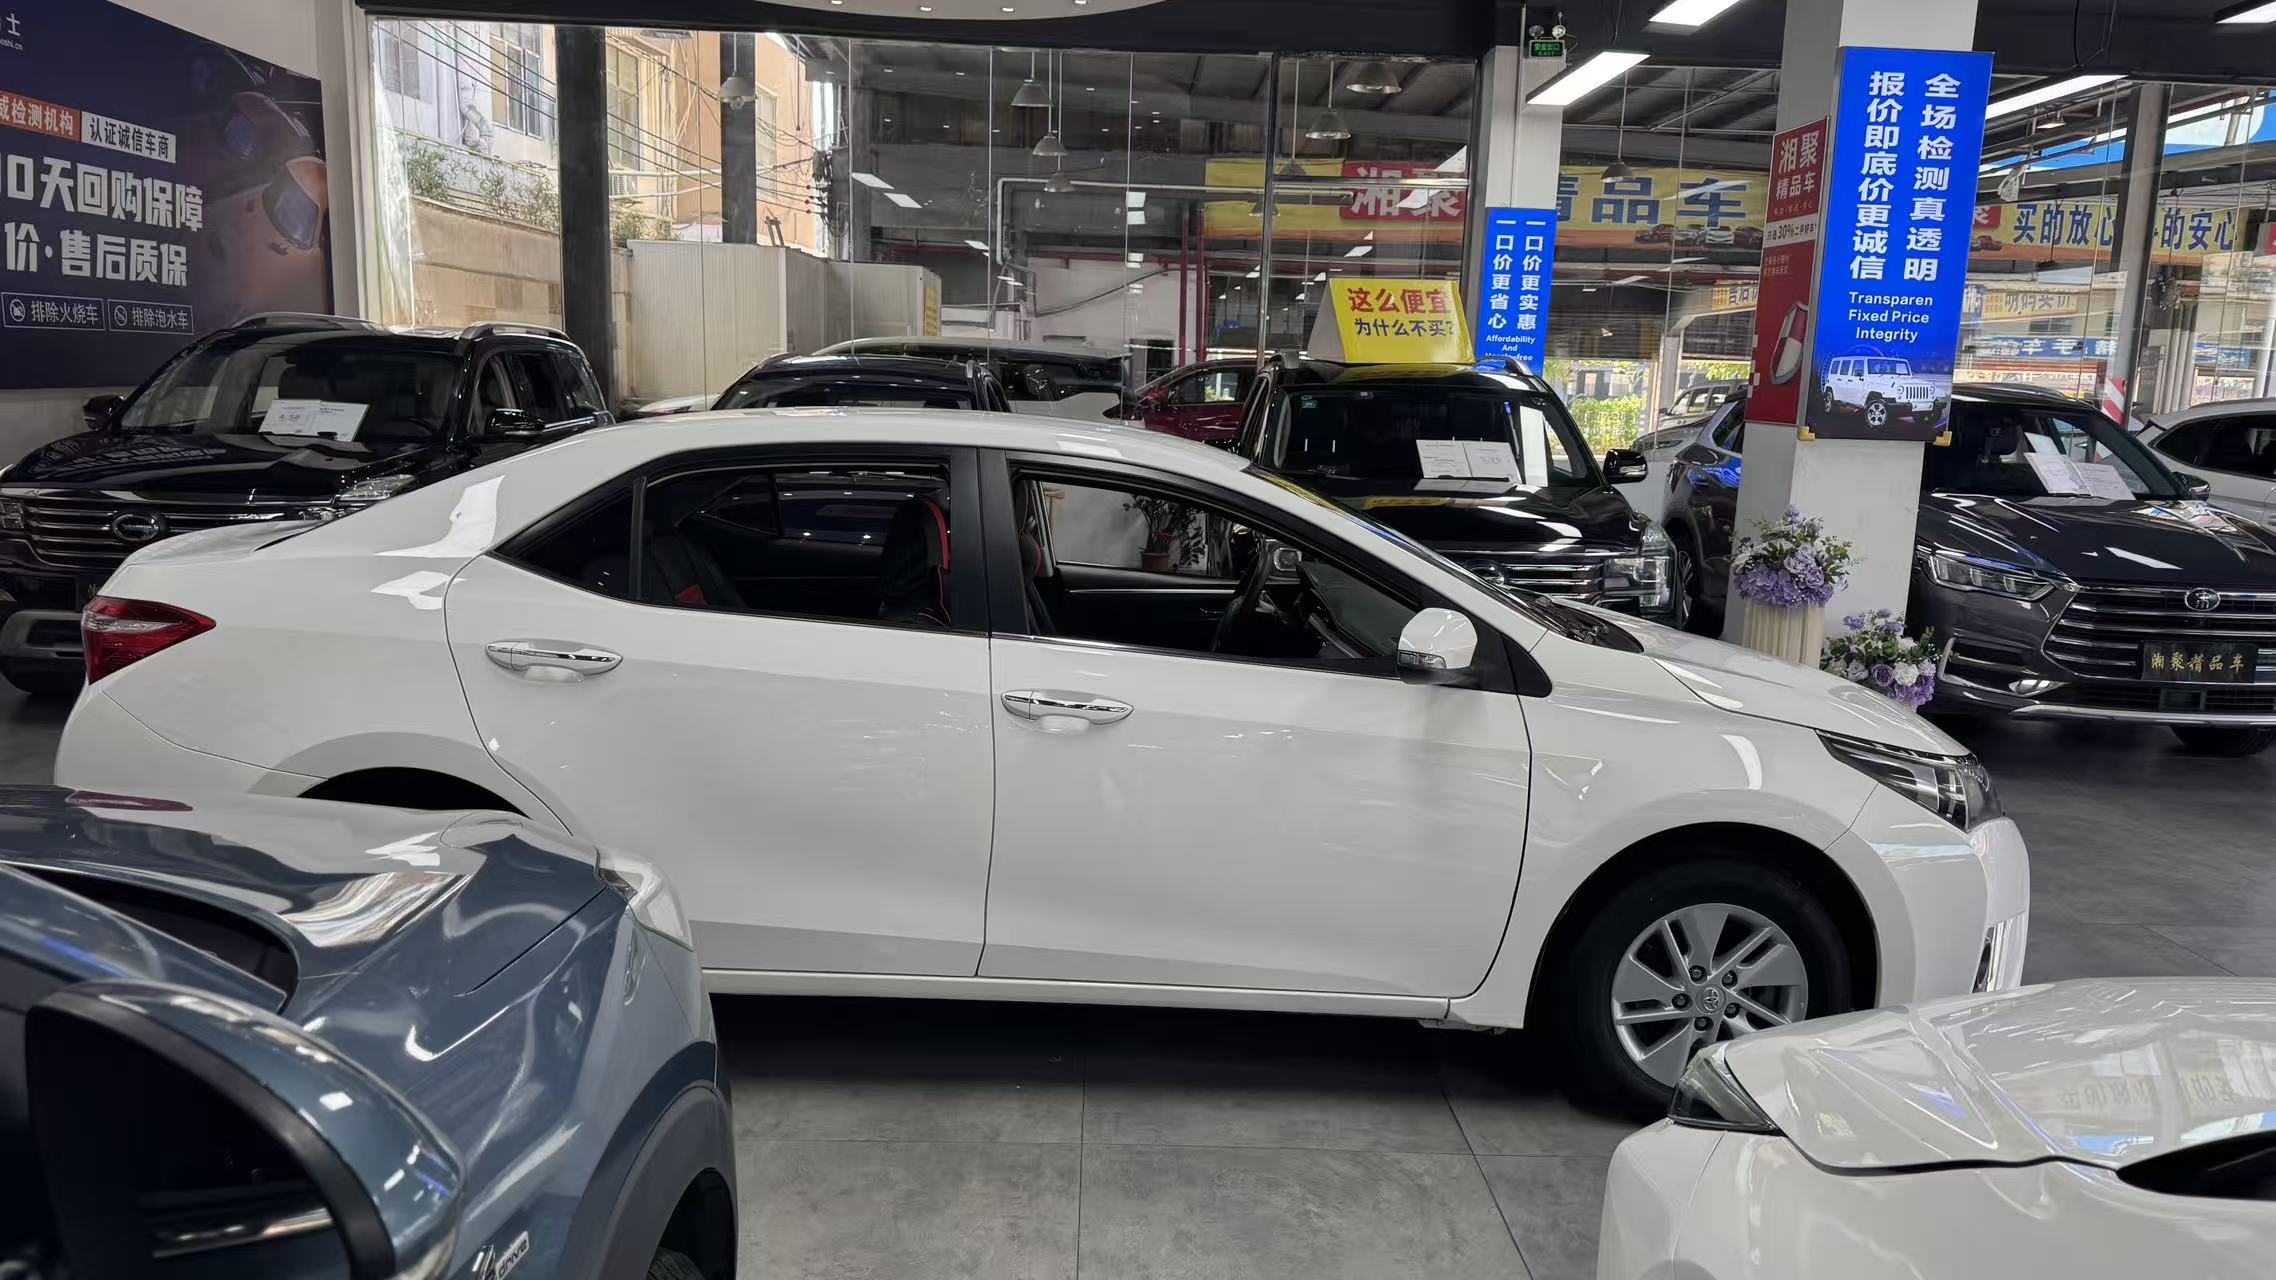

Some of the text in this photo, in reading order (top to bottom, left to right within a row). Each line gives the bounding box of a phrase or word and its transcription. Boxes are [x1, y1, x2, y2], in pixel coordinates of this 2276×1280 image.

[89, 118, 169, 159] 认证诚信车商
[1779, 131, 1819, 174] 湘聚
[1775, 171, 1816, 201] 精品车
[1850, 71, 1905, 281] 报价即底价更诚信
[1903, 73, 1961, 282] 全场检测真透明
[0, 154, 203, 232] 0天回购保障
[2012, 202, 2116, 247] 买的放心
[2152, 206, 2238, 251] 的安心
[1487, 219, 1517, 330] 一口价更省心
[1516, 220, 1547, 330] 一口价更实惠
[31, 300, 99, 325] 排除火烧车
[1347, 286, 1451, 315] 这么便宜
[1848, 291, 1934, 308] Transparen
[132, 307, 188, 329] 排除泡水车
[1354, 317, 1456, 337] 为什么不买?
[1848, 309, 1930, 324] Fixed Price
[1485, 334, 1536, 345] Affordability
[1501, 344, 1518, 352] And
[1855, 326, 1919, 343] Integrity
[2151, 651, 2245, 674] 湘聚精品车
